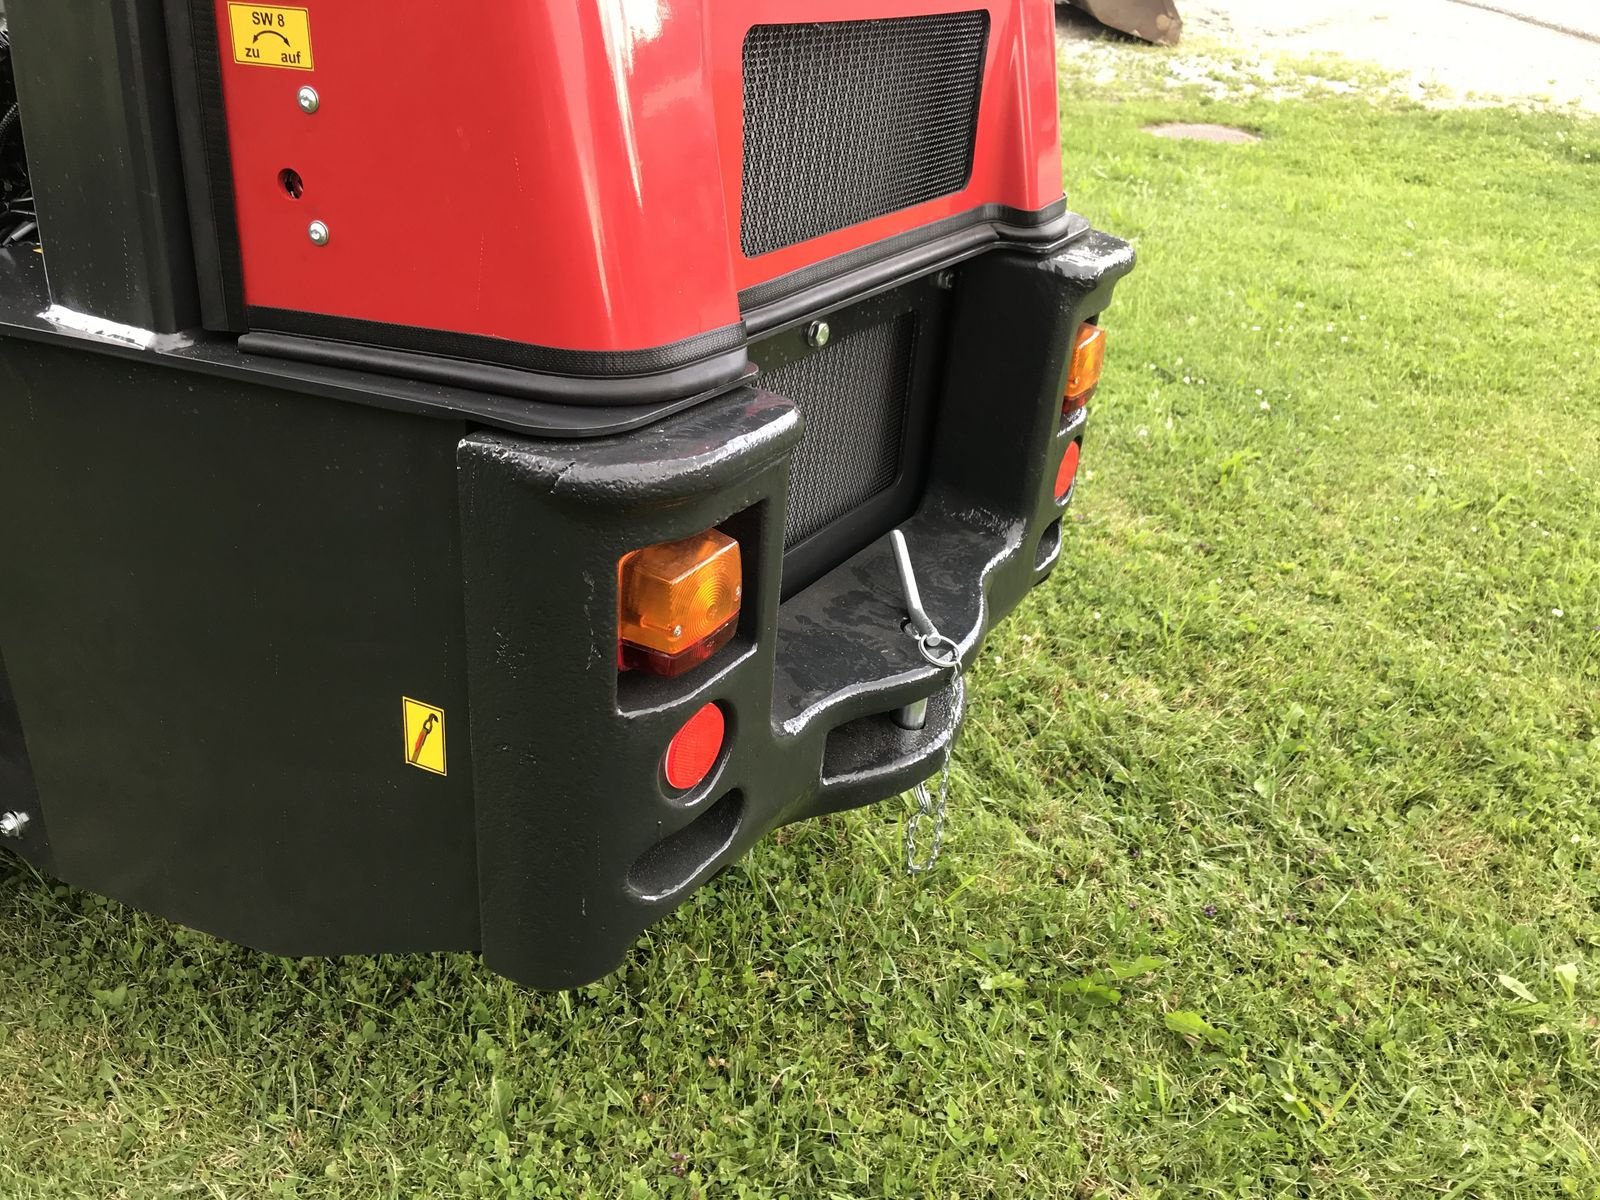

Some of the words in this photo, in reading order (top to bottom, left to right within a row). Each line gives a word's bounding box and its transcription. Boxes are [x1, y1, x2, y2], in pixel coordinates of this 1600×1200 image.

[252, 11, 272, 26] SW
[277, 14, 285, 27] 8
[245, 48, 260, 58] zu
[281, 51, 301, 64] auf
